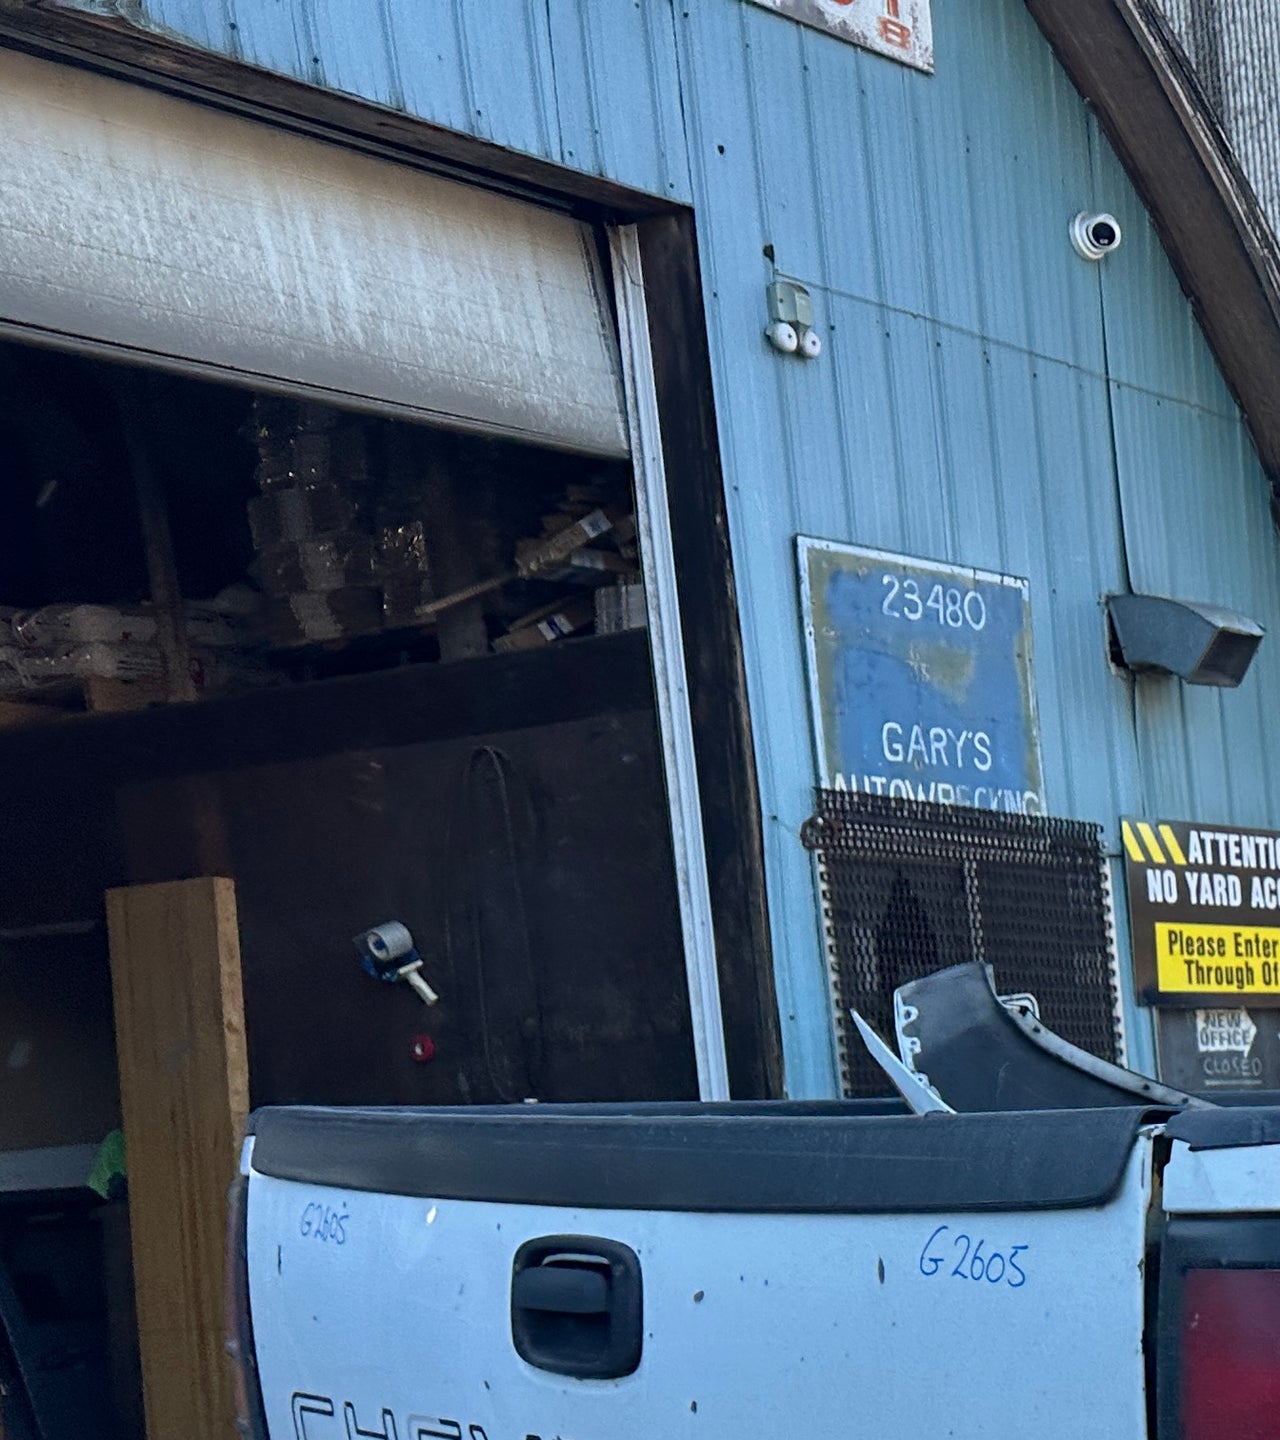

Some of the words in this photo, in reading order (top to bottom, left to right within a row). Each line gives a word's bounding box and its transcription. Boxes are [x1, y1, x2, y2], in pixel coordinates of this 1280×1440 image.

[882, 574, 987, 631] 23480
[882, 721, 992, 772] GARY'S
[1146, 868, 1178, 904] NO
[1184, 872, 1242, 908] YARD
[1167, 930, 1226, 957] Please
[1233, 932, 1279, 959] Enter
[1184, 960, 1256, 990] Through
[1204, 1010, 1242, 1028] NEW
[1200, 1027, 1251, 1047] OFFICE
[1203, 1057, 1263, 1077] CLOSED
[919, 1225, 1029, 1288] G2605
